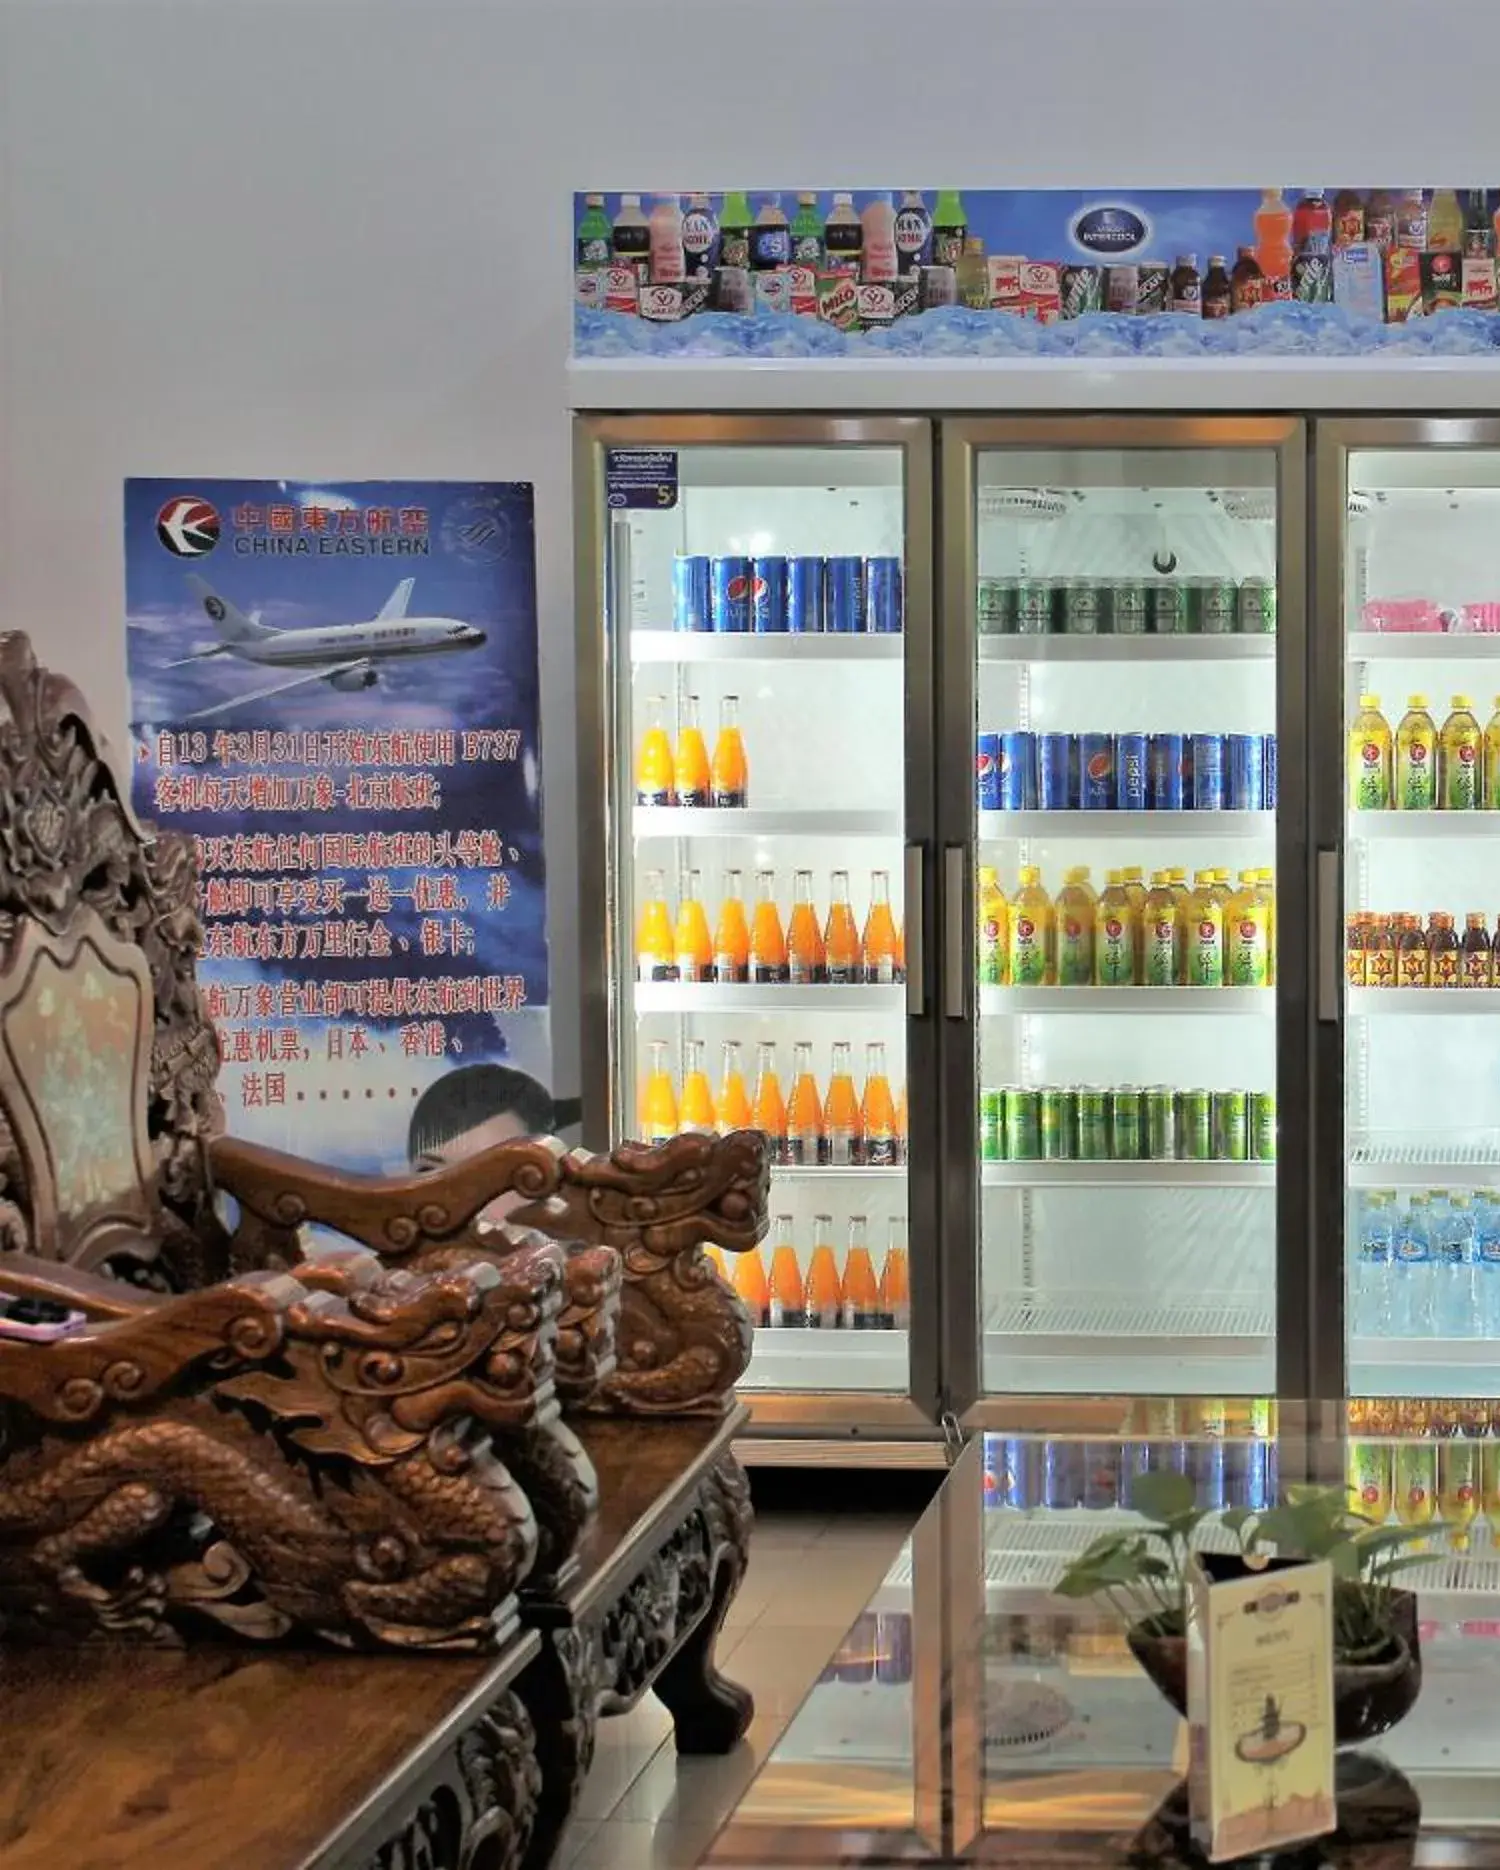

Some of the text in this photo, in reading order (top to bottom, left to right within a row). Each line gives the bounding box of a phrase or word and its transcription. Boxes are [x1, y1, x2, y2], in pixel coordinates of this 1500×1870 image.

[234, 537, 430, 556] CHINA EASTERN
[460, 729, 522, 761] B737
